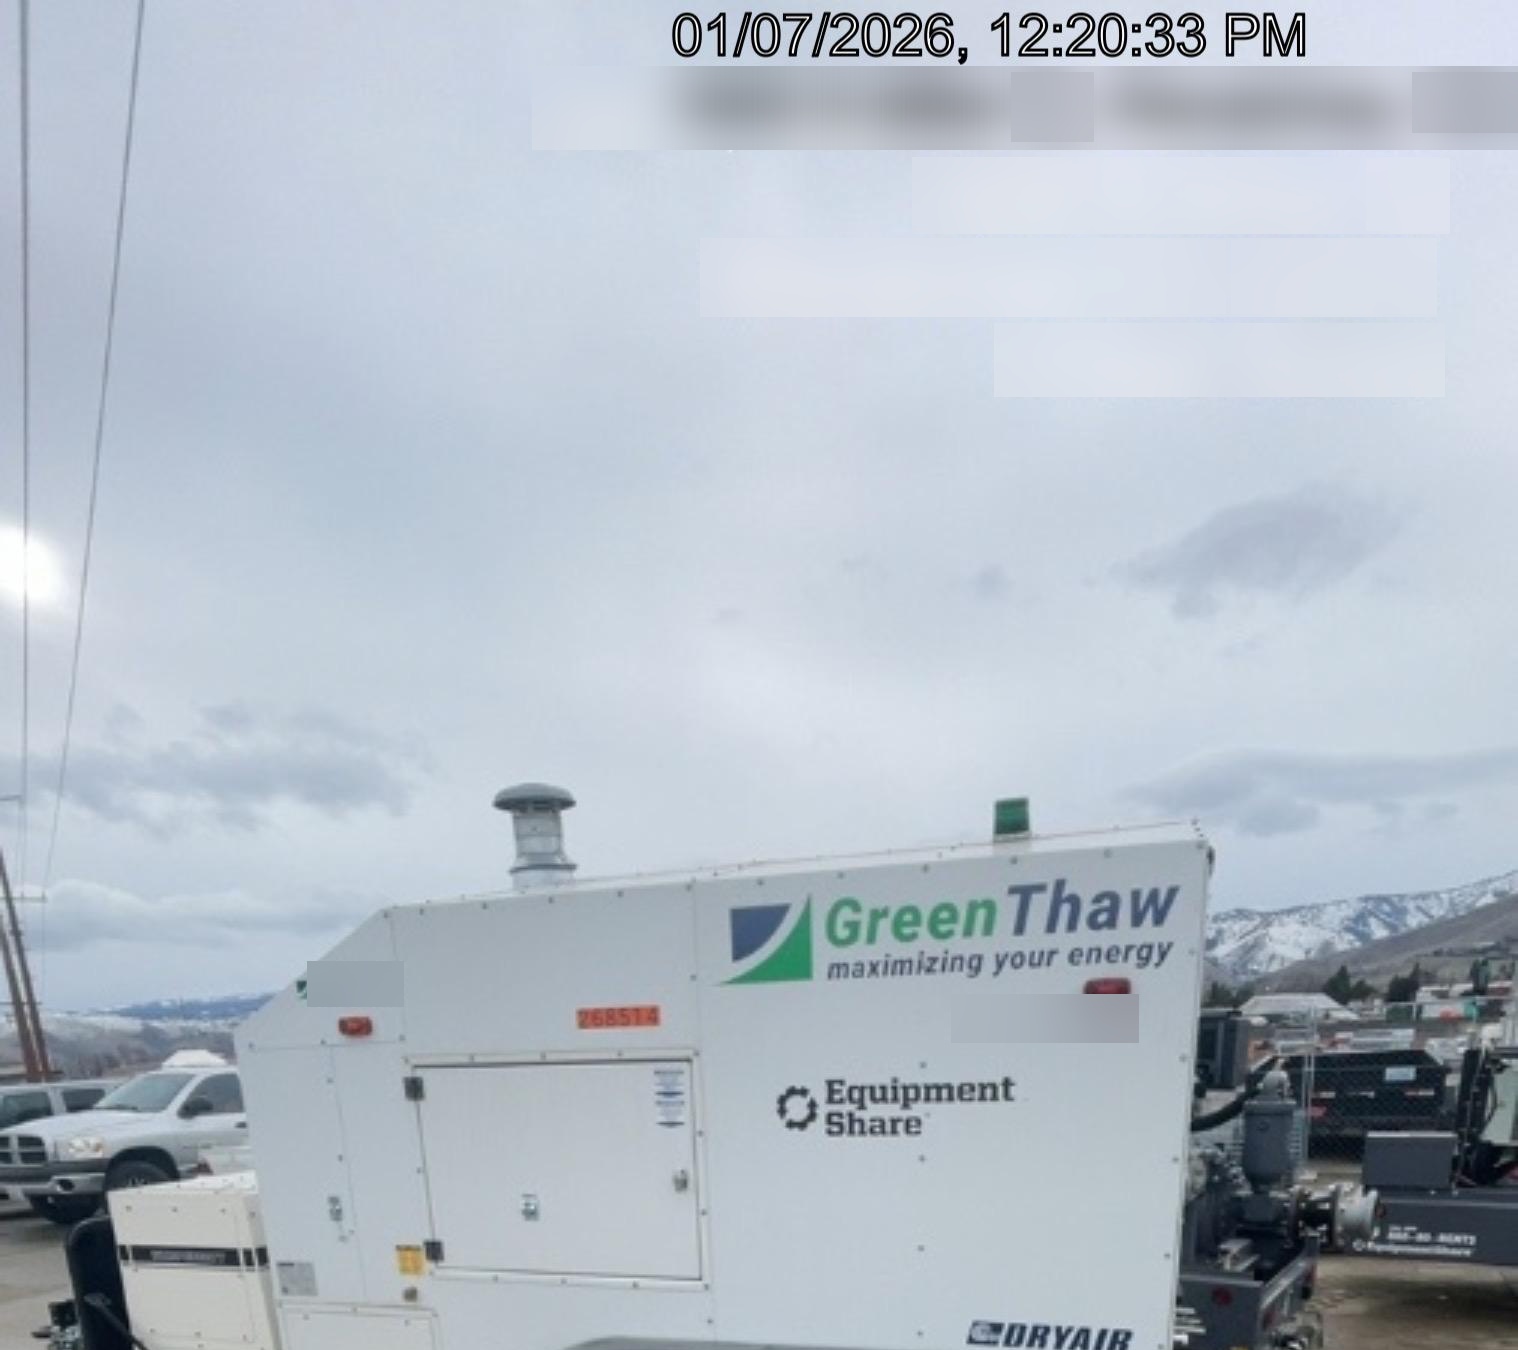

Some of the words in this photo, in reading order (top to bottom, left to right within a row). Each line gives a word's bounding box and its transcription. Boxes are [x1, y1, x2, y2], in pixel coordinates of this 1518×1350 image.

[827, 950, 984, 980] maximizing
[993, 947, 1061, 976] your
[1067, 941, 1175, 969] energy
[825, 1076, 1016, 1111] Equipment
[825, 1111, 922, 1137] Share
